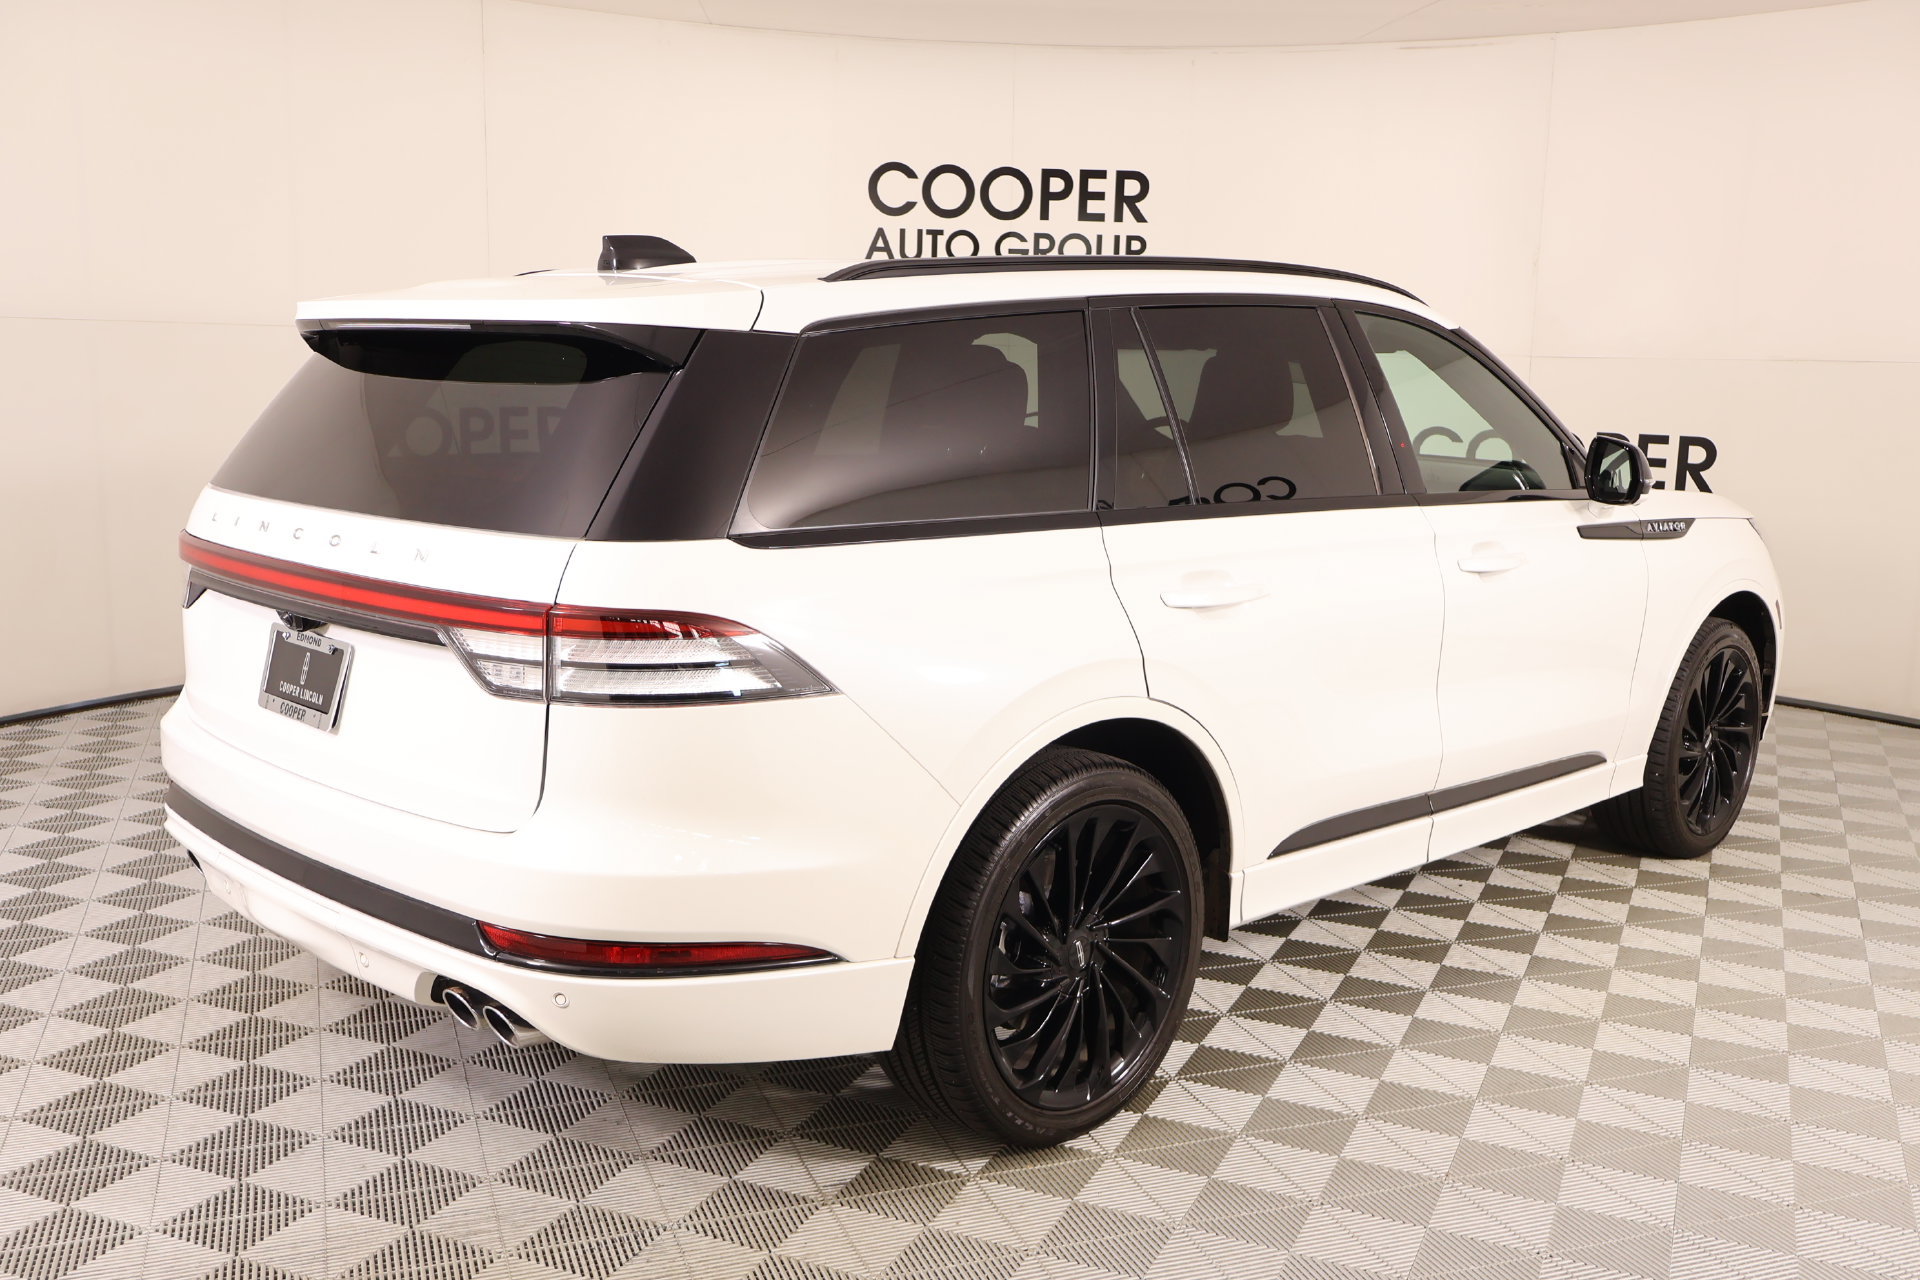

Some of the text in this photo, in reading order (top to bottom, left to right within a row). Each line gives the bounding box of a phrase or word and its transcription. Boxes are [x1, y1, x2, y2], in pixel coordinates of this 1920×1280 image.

[868, 161, 1150, 223] COOPER
[865, 227, 1147, 259] AUTO GROUP
[211, 511, 429, 563] LINCOLN
[1647, 521, 1686, 532] AVIATOR
[296, 632, 322, 647] EDMOND
[279, 681, 324, 706] COOPER LINCOLN
[280, 702, 307, 721] COOPER
